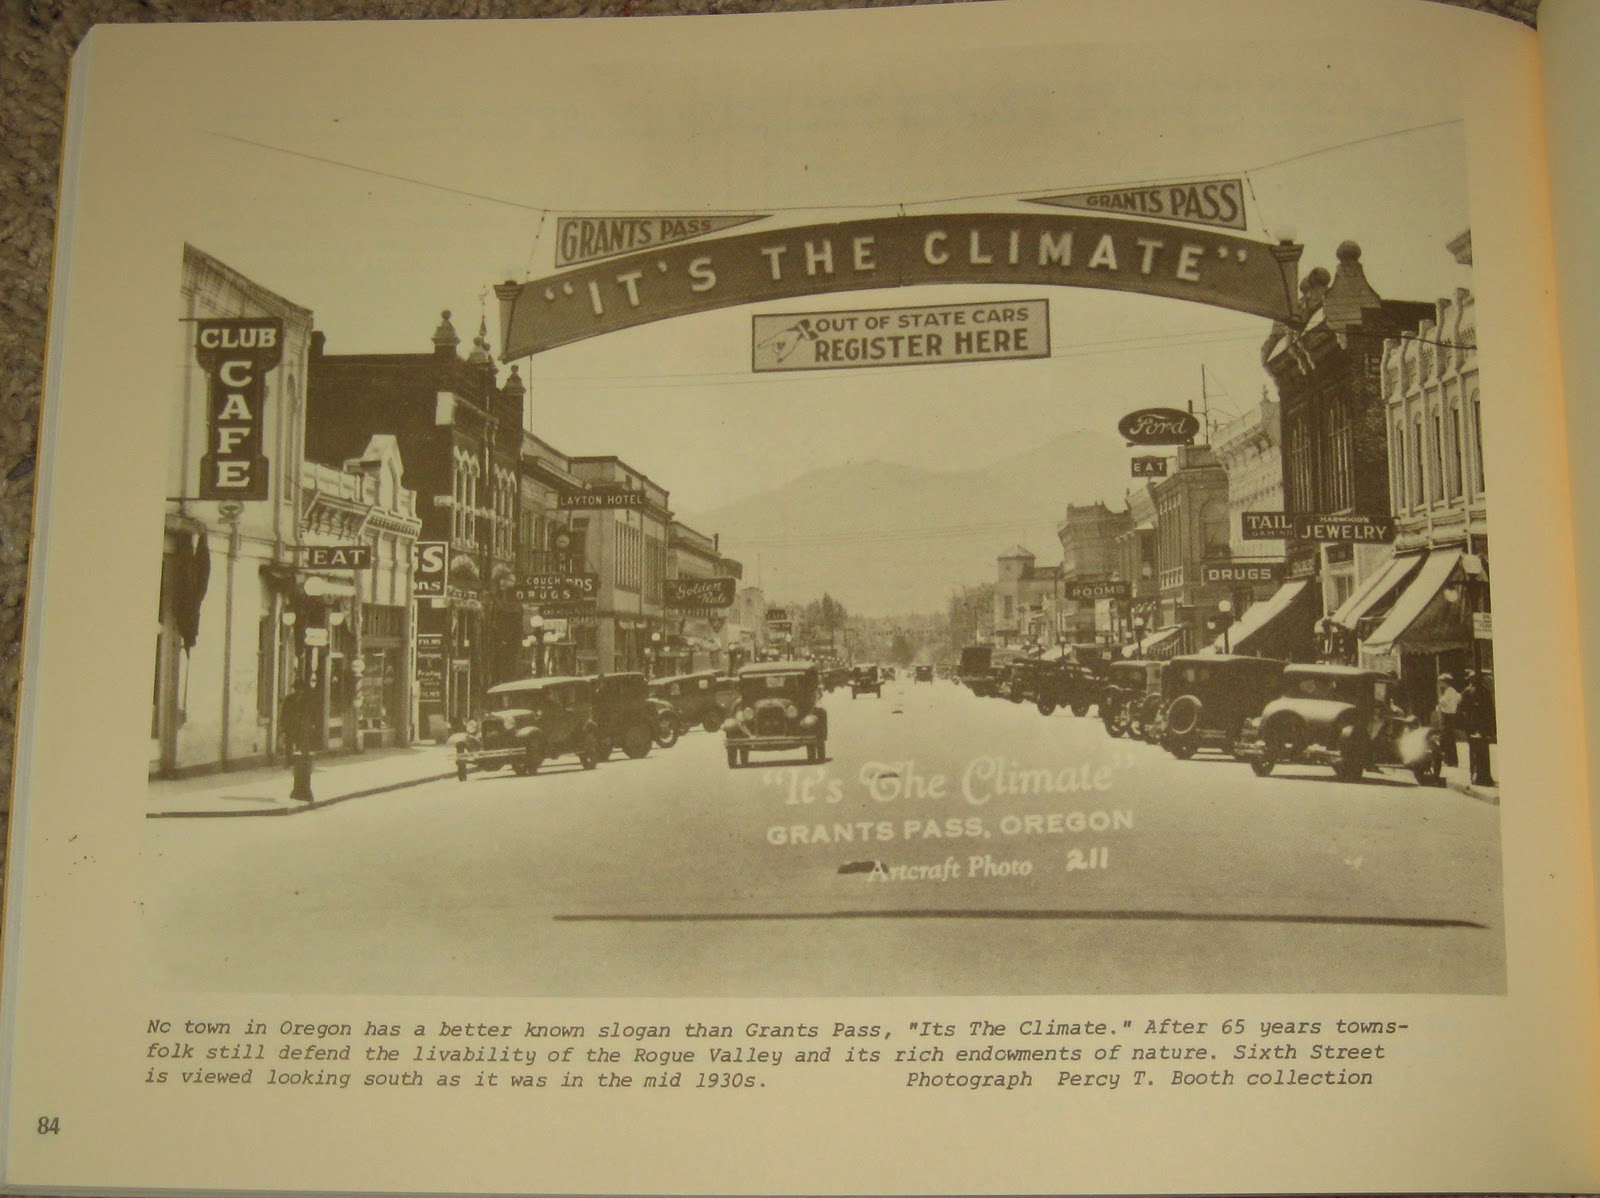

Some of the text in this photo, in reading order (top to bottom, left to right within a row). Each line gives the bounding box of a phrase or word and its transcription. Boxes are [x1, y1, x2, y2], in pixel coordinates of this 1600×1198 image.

[1086, 183, 1240, 222] GRANTS PASS
[560, 217, 712, 262] GRANTS PASS
[761, 236, 876, 281] THE
[815, 307, 1029, 333] OUT OF STATE CARS
[200, 327, 276, 349] CLUB
[815, 328, 1029, 362] REGISTER HERE
[215, 360, 252, 489] CAFE
[1129, 414, 1187, 435] Ford
[1133, 461, 1165, 472] EAT
[560, 495, 643, 506] LAYTON HOTEL
[1247, 515, 1293, 529] TAIL
[1301, 525, 1387, 540] JEWELRY
[313, 551, 366, 565] EAT
[526, 577, 561, 585] COUCH
[1208, 569, 1271, 581] DRUGS
[677, 582, 721, 599] Golden
[1072, 585, 1125, 597] ROOMS
[184, 1019, 231, 1035] town
[244, 1018, 267, 1035] in
[279, 1020, 352, 1039] Oregon
[364, 1020, 401, 1037] has
[413, 1024, 426, 1037] a
[438, 1021, 513, 1038] better
[523, 1021, 585, 1038] known
[598, 1021, 671, 1042] slogan
[684, 1022, 733, 1038] than
[745, 1022, 819, 1038] Grants
[831, 1022, 891, 1040] Pass,
[909, 1021, 956, 1037] "Its
[969, 1020, 1007, 1037] The
[1019, 1018, 1132, 1036] Climate."
[1143, 1018, 1209, 1035] After
[1221, 1018, 1246, 1035] 65
[1260, 1021, 1322, 1038] years
[1335, 1018, 1409, 1035] towns-
[146, 1042, 1386, 1067] folk still defend the livability of the Rogue Valley and its rich endowments of nature. Sixth Street
[144, 1066, 766, 1089] is viewed looking south as it was in the mid 1930s.
[905, 1068, 1373, 1091] Photograph Percy T. Booth collection
[37, 1116, 60, 1134] 84
